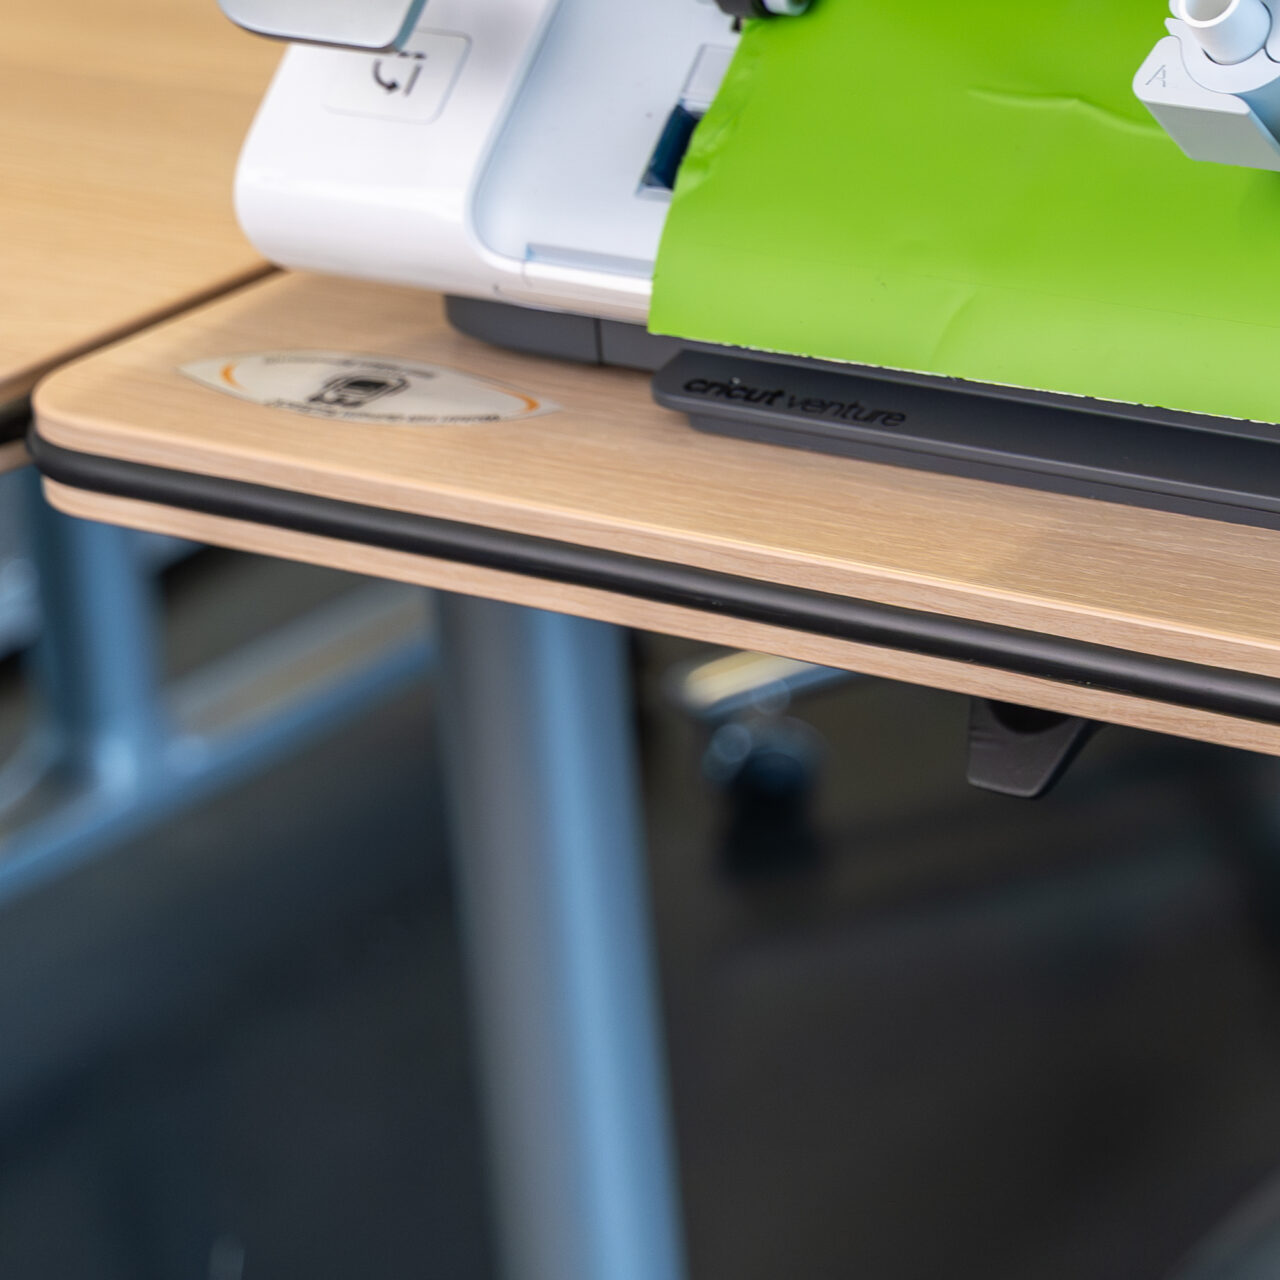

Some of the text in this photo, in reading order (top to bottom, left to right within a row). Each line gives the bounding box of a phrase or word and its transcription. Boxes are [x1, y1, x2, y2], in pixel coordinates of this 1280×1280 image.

[1145, 64, 1166, 88] A
[683, 376, 907, 427] cricut venture
